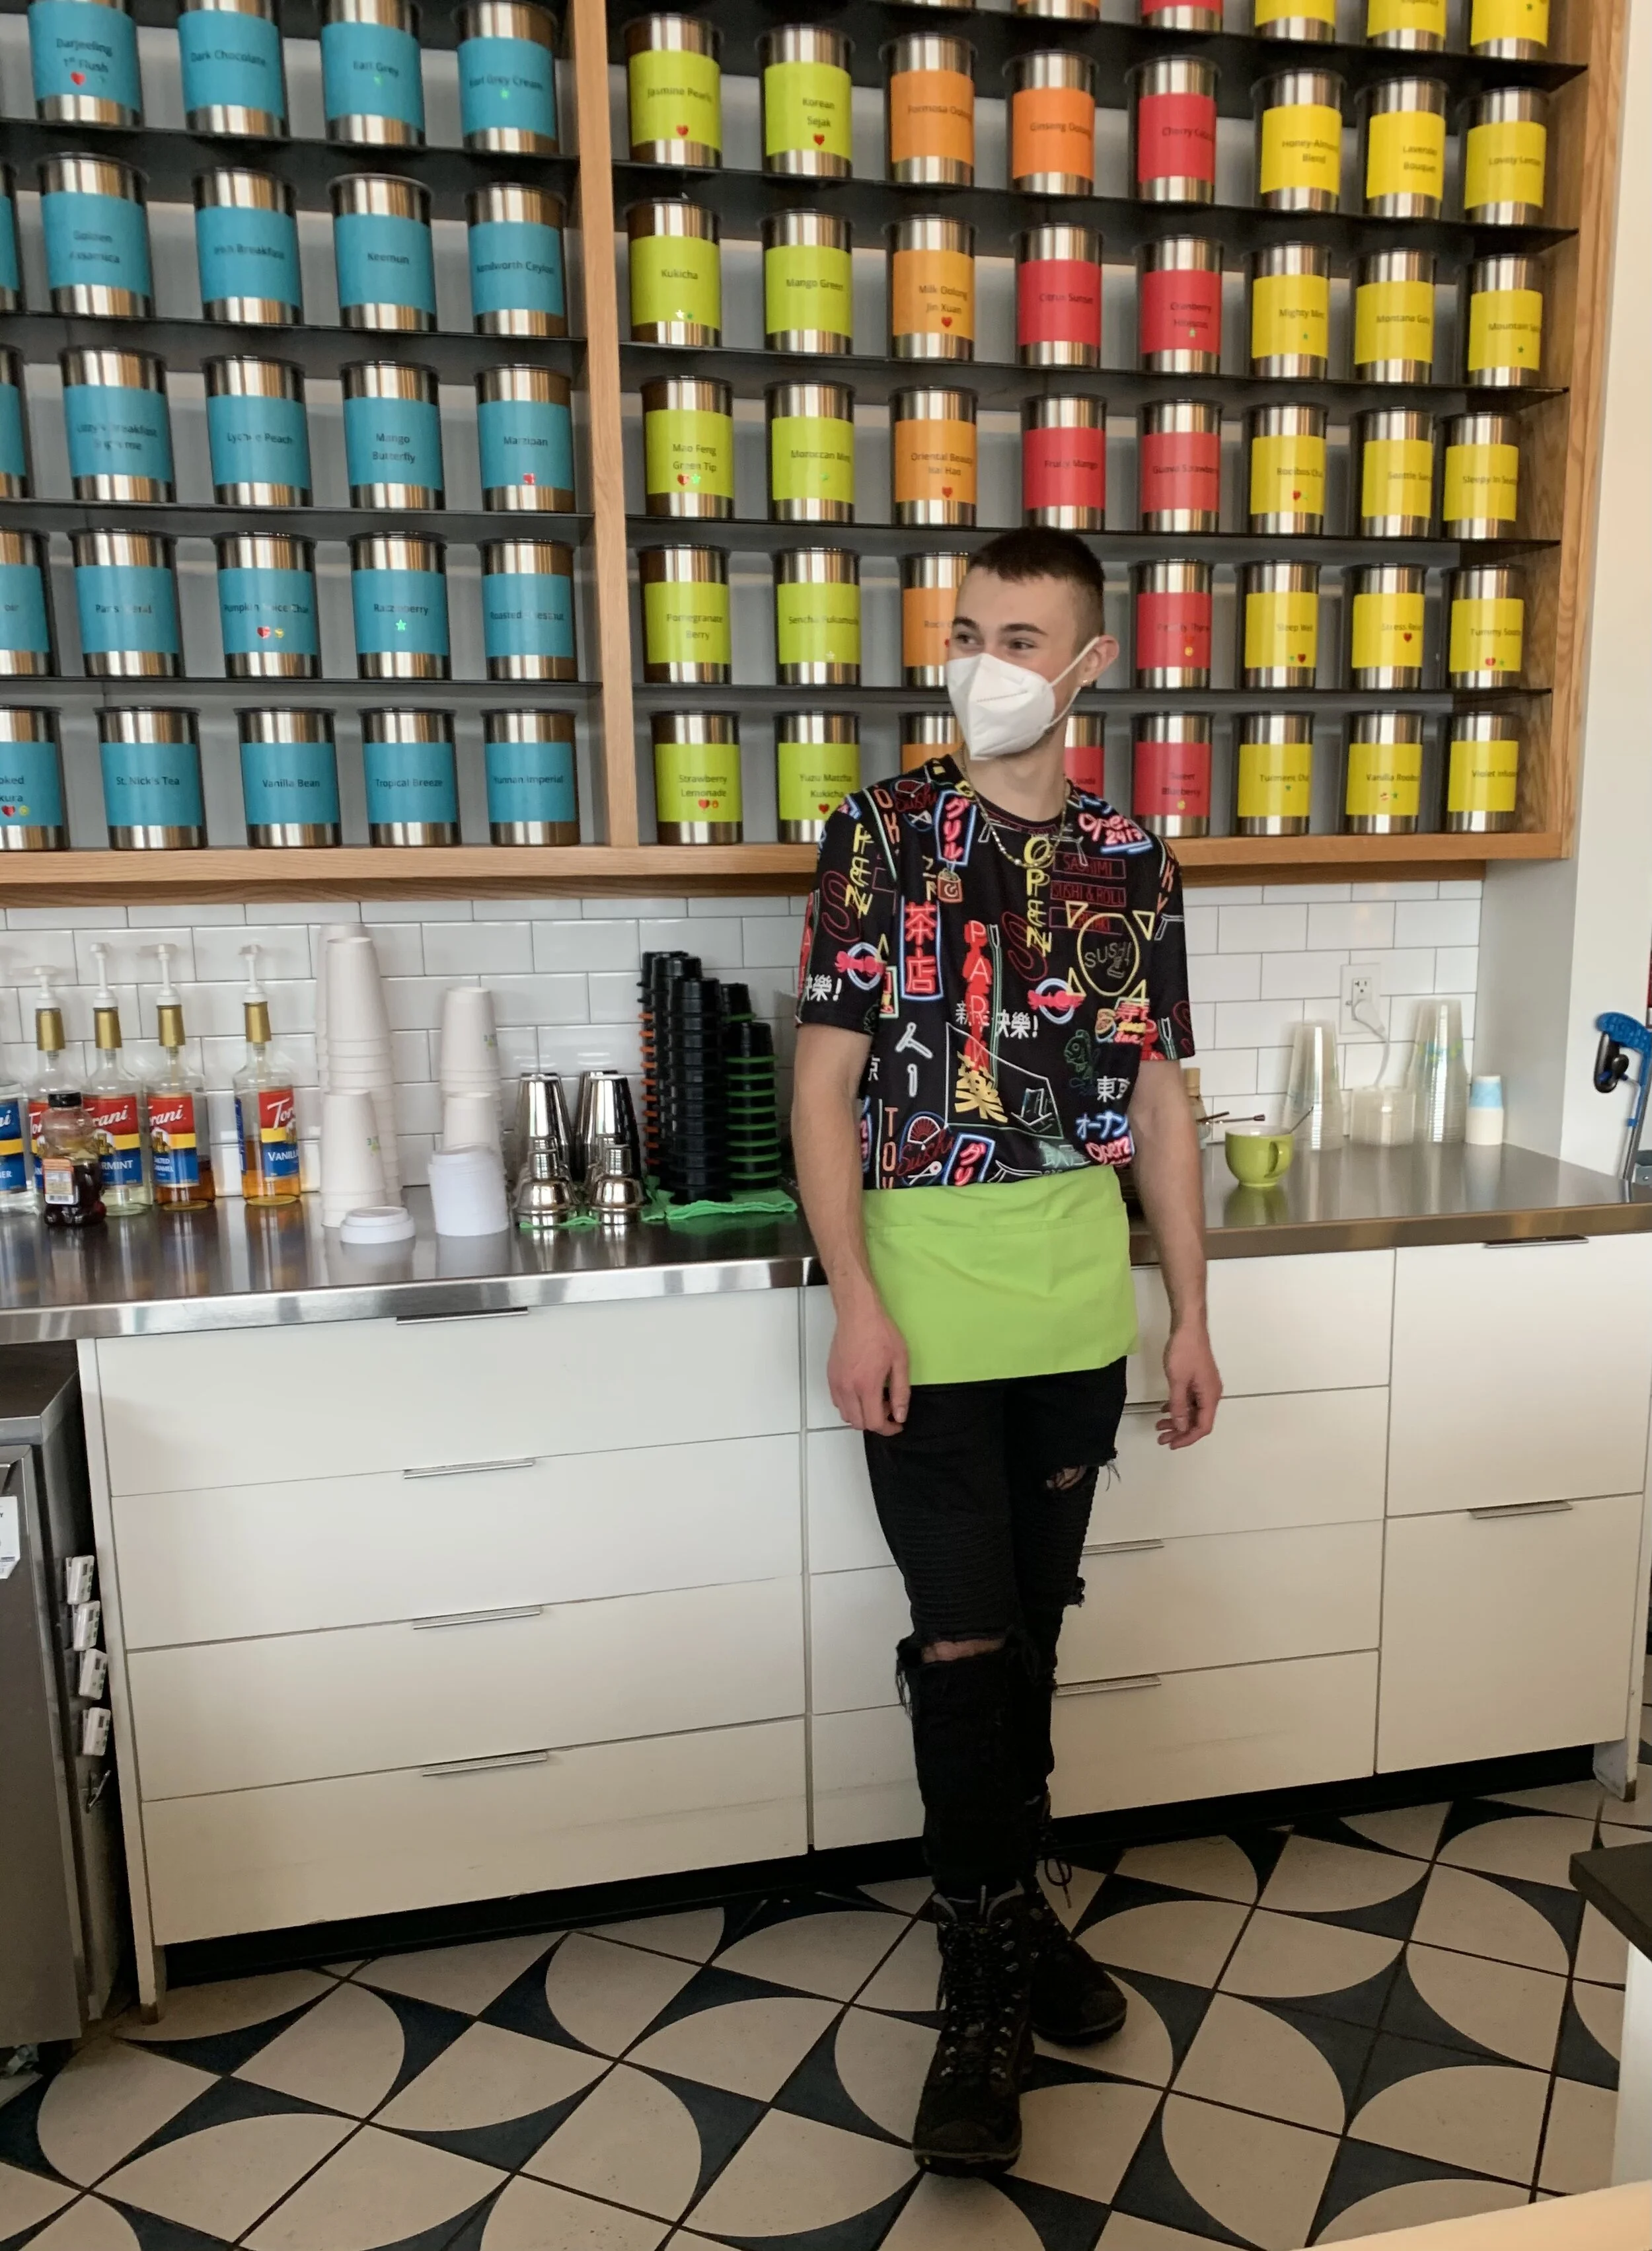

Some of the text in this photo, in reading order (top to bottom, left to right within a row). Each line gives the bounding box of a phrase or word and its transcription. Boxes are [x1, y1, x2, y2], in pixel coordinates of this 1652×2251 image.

[56, 38, 112, 57] Darjeeling
[79, 59, 108, 73] Flush
[648, 87, 685, 98] Jasmine
[802, 97, 835, 110] Korean
[660, 269, 697, 280] Kukicha
[785, 278, 843, 291] Mango Green
[918, 285, 937, 294] Milk
[925, 303, 961, 315] Jin Xuan
[263, 432, 292, 445] Peach
[375, 433, 409, 446] Mango
[503, 436, 548, 447] Marzipan
[672, 442, 716, 457] Mao Feng
[372, 450, 415, 465] Butterfly
[909, 451, 948, 462] Oriental
[672, 460, 717, 473] Green Tip
[944, 467, 961, 476] Hao
[223, 602, 258, 615] Pumpkin
[490, 609, 522, 621] Roasted
[666, 613, 724, 624] Pomegranate
[685, 629, 710, 640] Berry
[1468, 629, 1500, 638] Tummy
[162, 777, 180, 786] Tea
[262, 779, 320, 789] Vanilla Bean
[376, 778, 443, 790] Tropical Breeze
[526, 775, 563, 787] Imperial
[678, 774, 727, 786] Strawberry
[822, 774, 851, 783] Matcha
[680, 789, 727, 798] Lemonade
[809, 790, 845, 798] Kukicha
[1024, 835, 1055, 958] OPEN
[267, 1098, 294, 1130] Tor
[100, 1159, 133, 1170] RMINT
